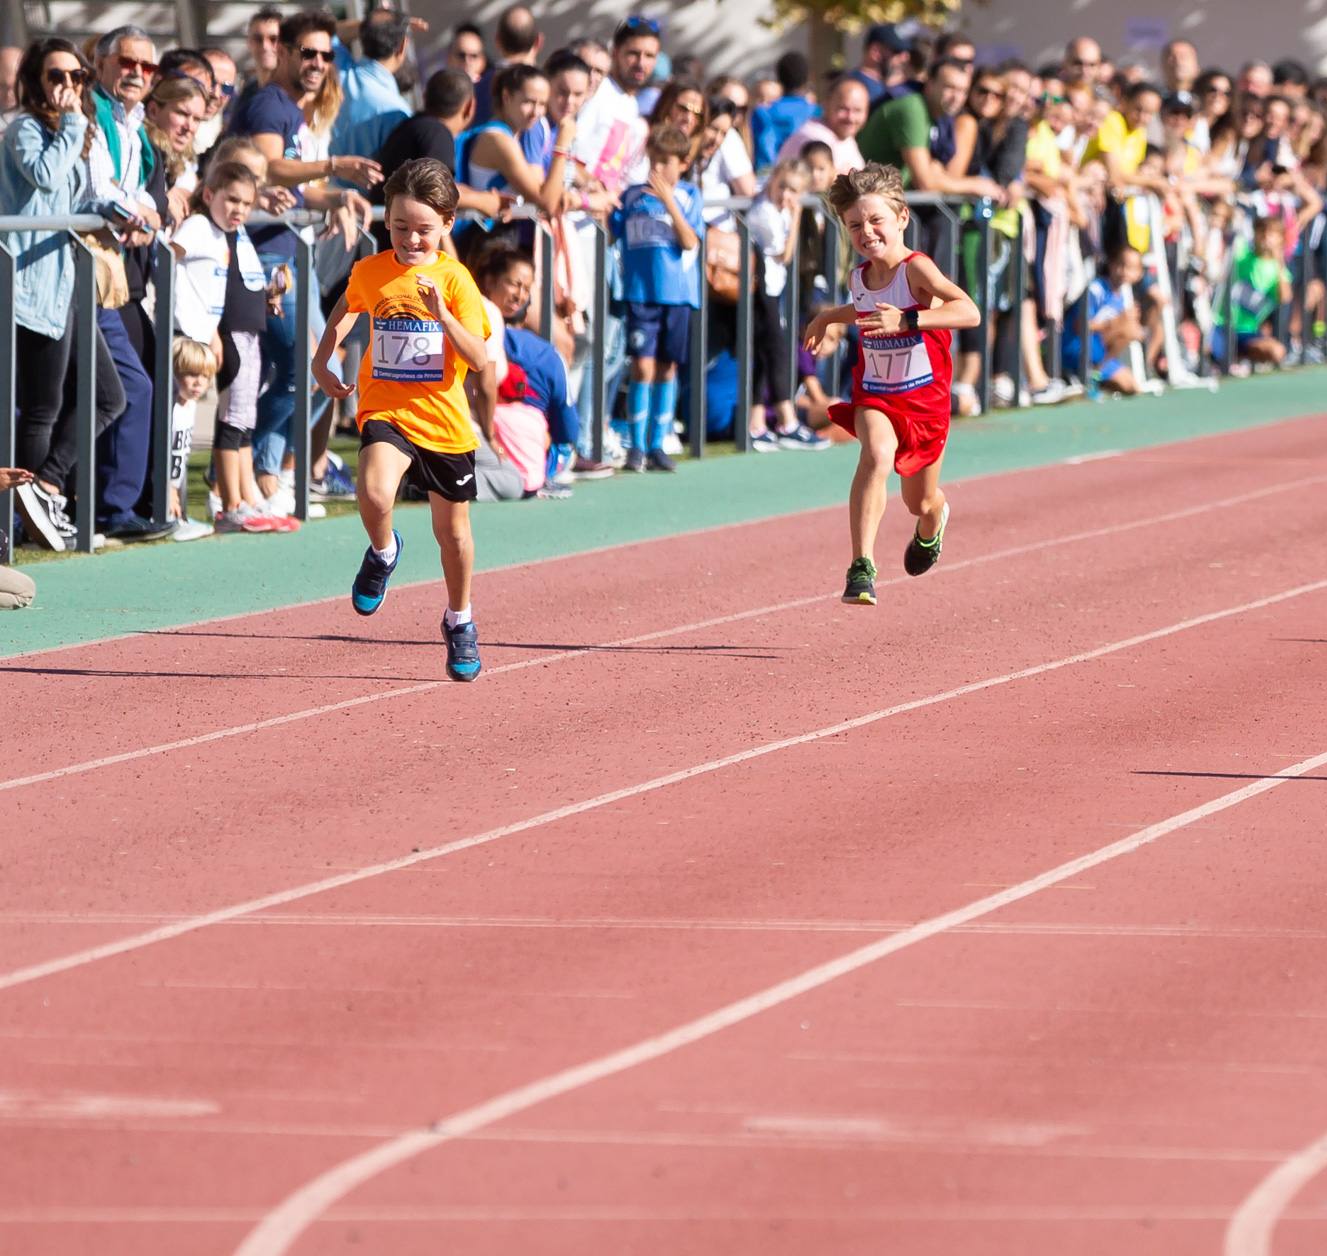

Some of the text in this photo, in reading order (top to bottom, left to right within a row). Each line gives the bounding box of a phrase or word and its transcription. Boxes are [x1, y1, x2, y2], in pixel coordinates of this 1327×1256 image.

[389, 320, 440, 331] HEMAFIX
[377, 334, 432, 366] 178
[873, 336, 919, 349] HEMAFIX
[869, 350, 913, 380] 177
